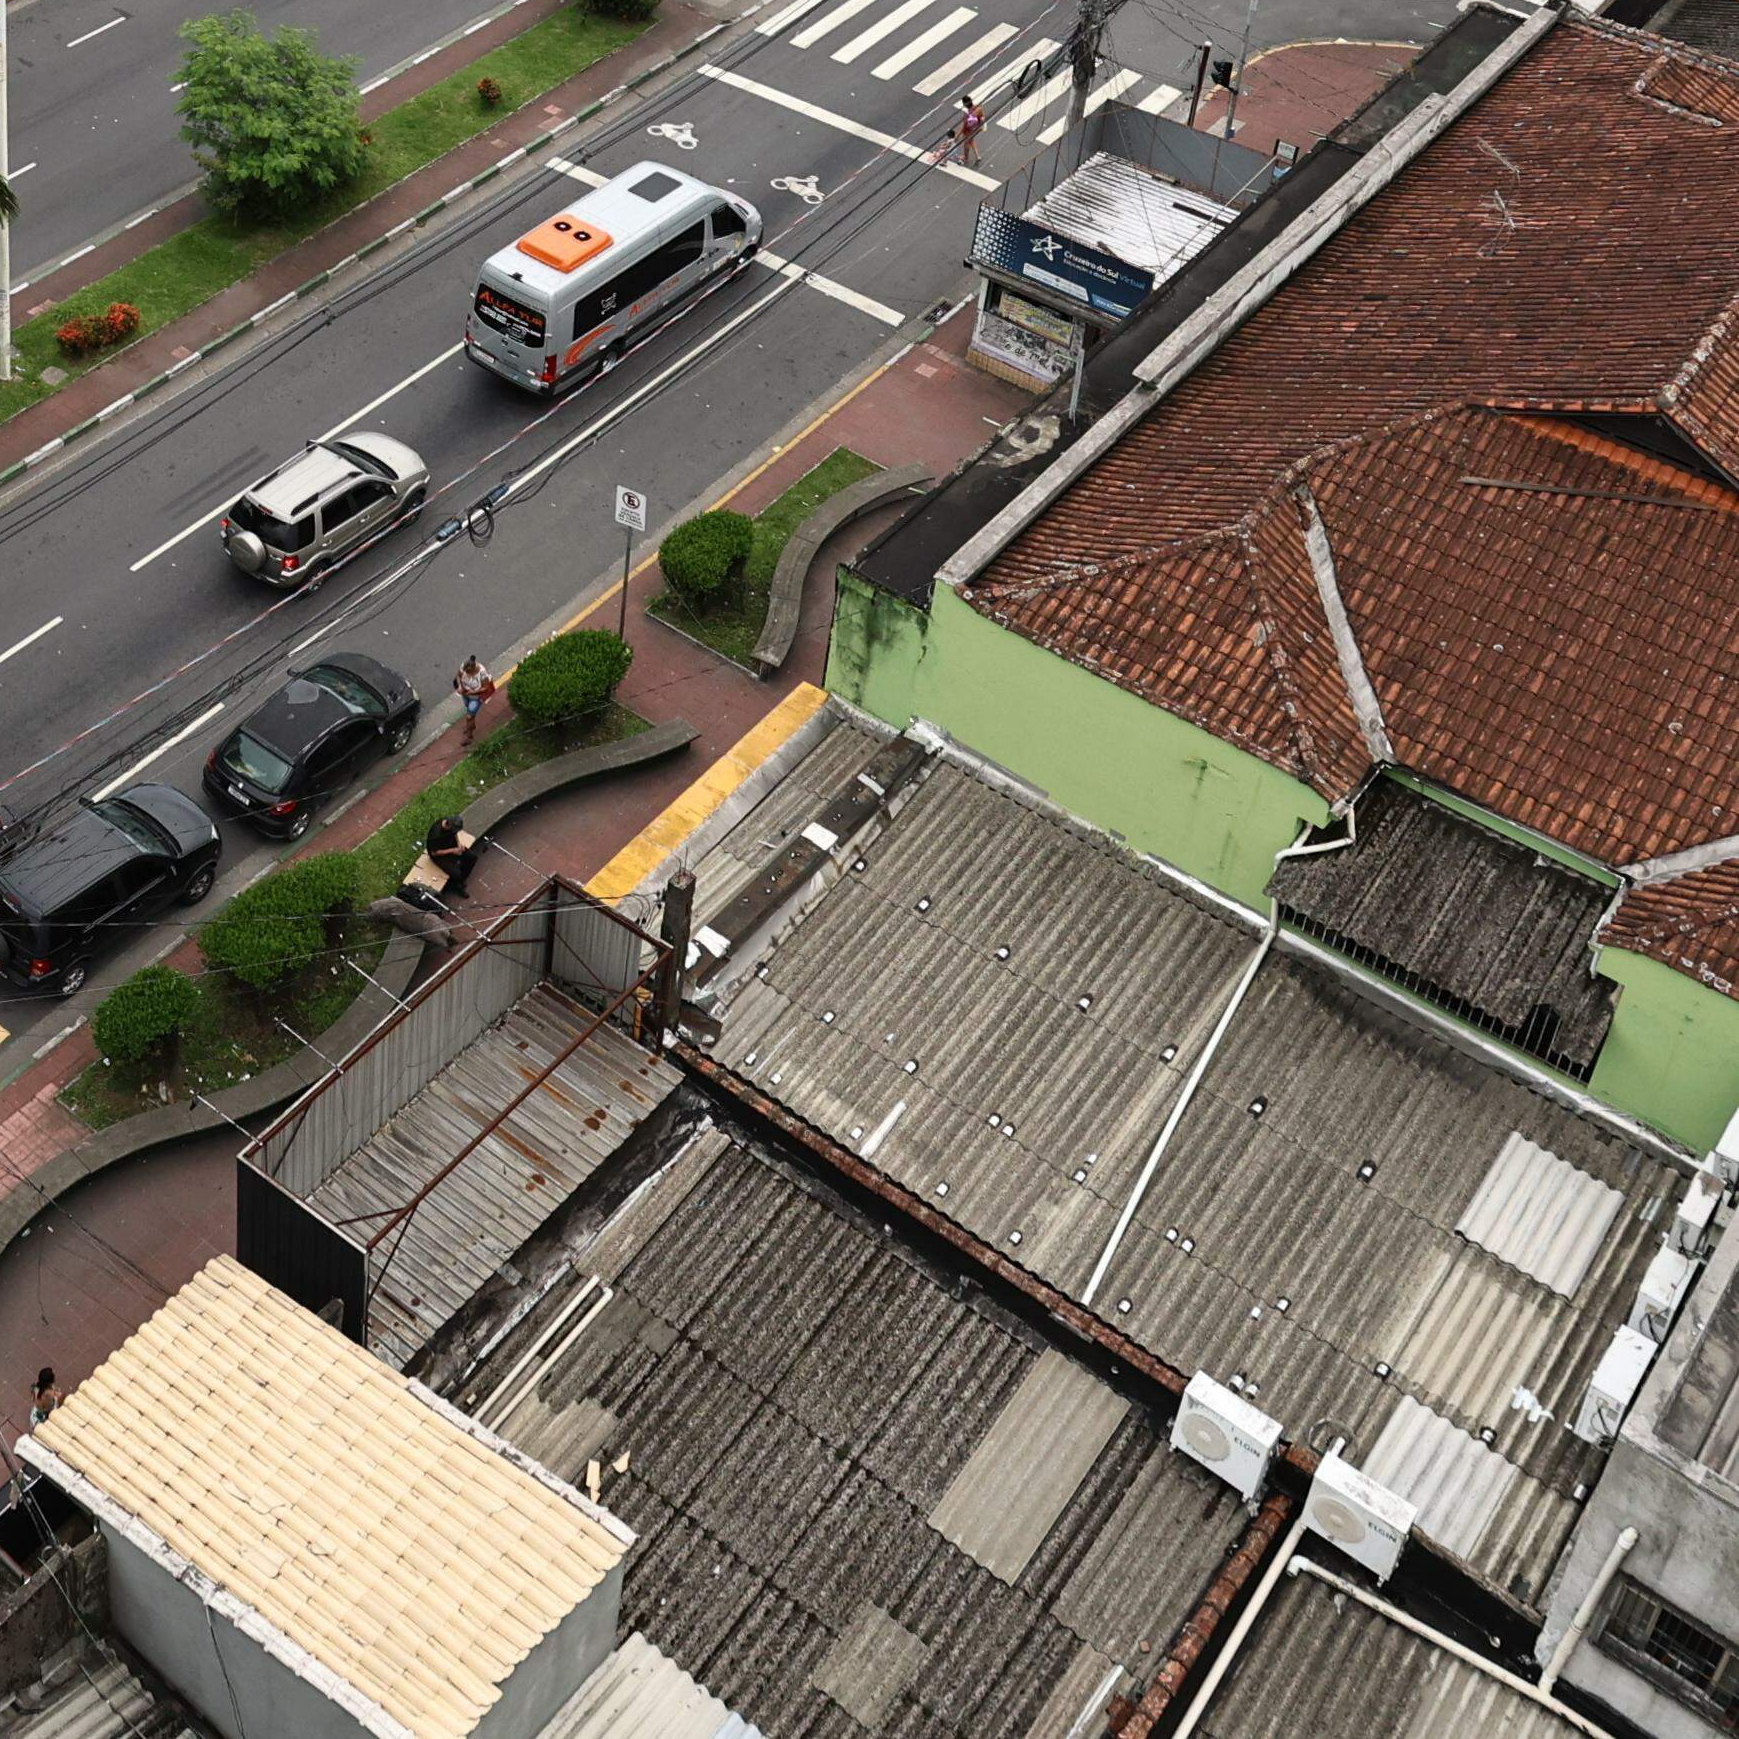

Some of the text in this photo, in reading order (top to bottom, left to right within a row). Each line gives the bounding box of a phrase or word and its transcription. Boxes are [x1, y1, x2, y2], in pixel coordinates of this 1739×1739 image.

[1063, 250, 1096, 269] Cruzeiro
[1096, 263, 1107, 274] do
[1107, 268, 1119, 279] Sul
[1234, 1437, 1261, 1458] ELGIN
[1368, 1521, 1397, 1543] ELGIN
